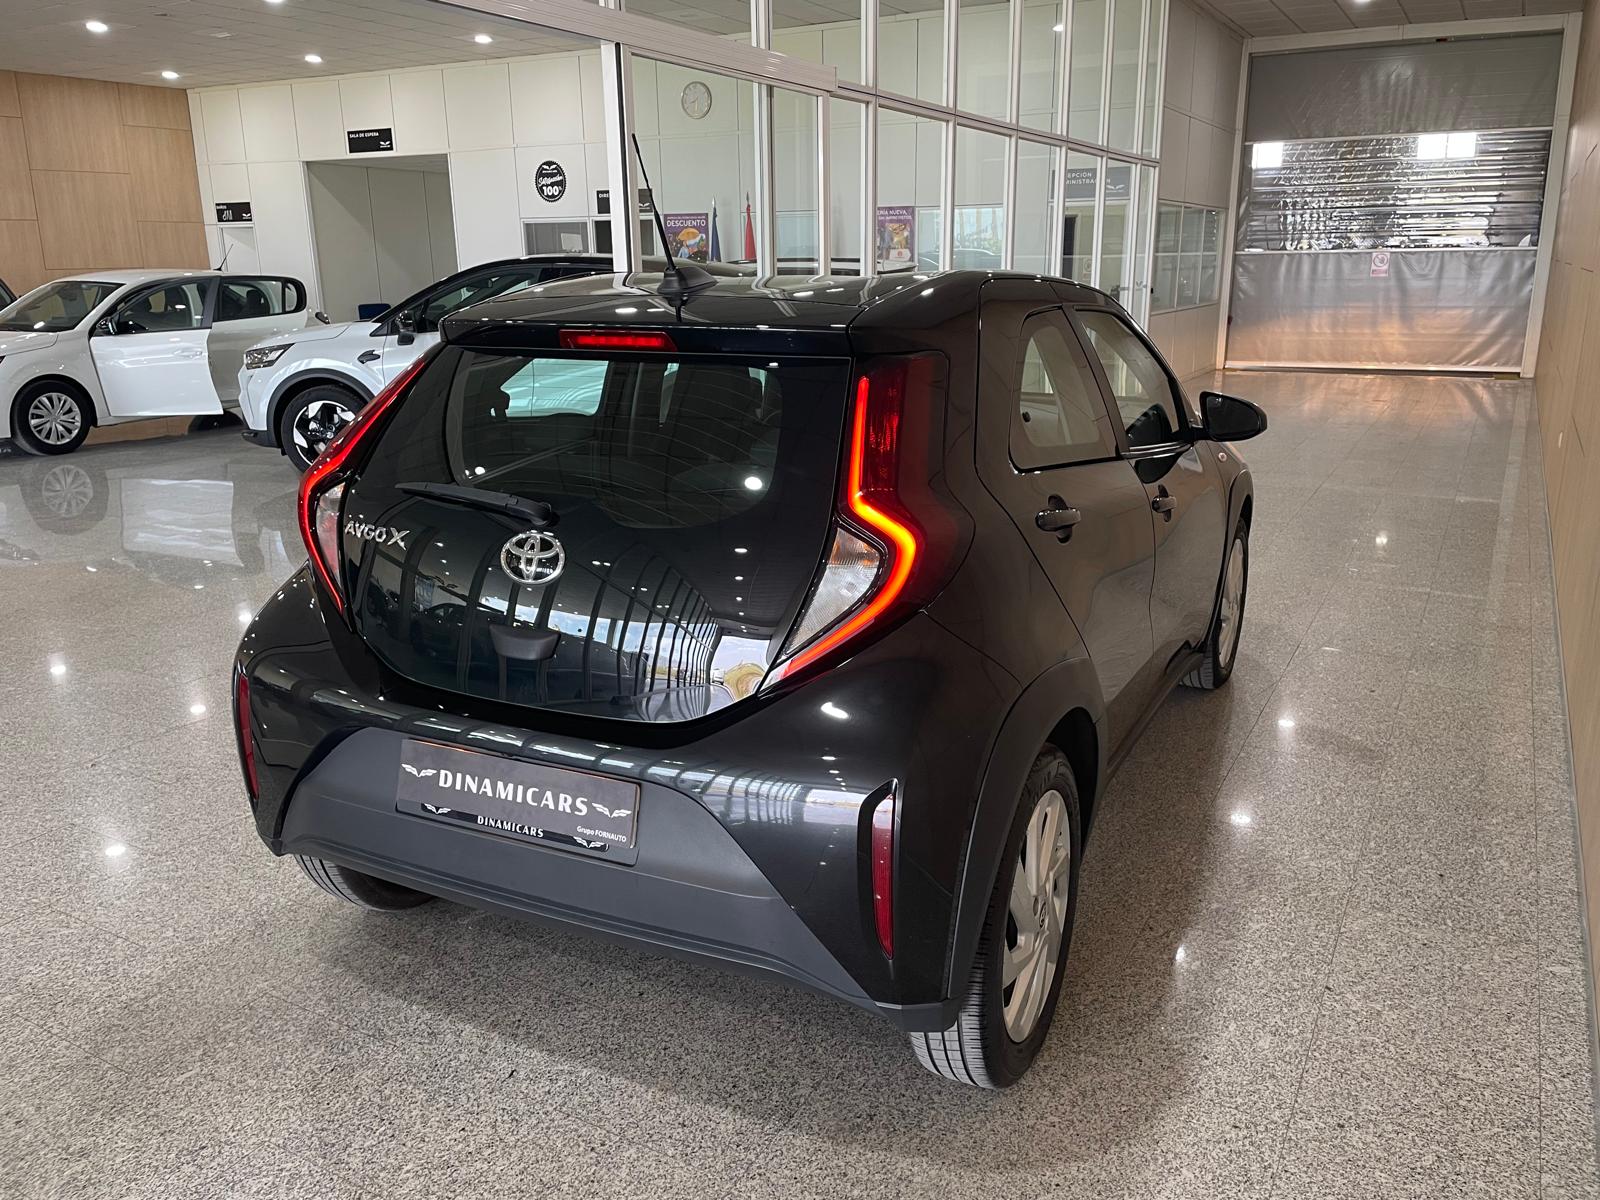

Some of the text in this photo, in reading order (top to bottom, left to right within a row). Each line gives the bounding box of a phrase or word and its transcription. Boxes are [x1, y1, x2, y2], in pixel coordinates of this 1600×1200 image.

[666, 219, 706, 228] DESCUENTO
[387, 527, 411, 551] X
[438, 769, 589, 816] DINAMICARS
[477, 815, 544, 838] DINAMICARS
[576, 825, 627, 842] Grupo FORNAUTO
